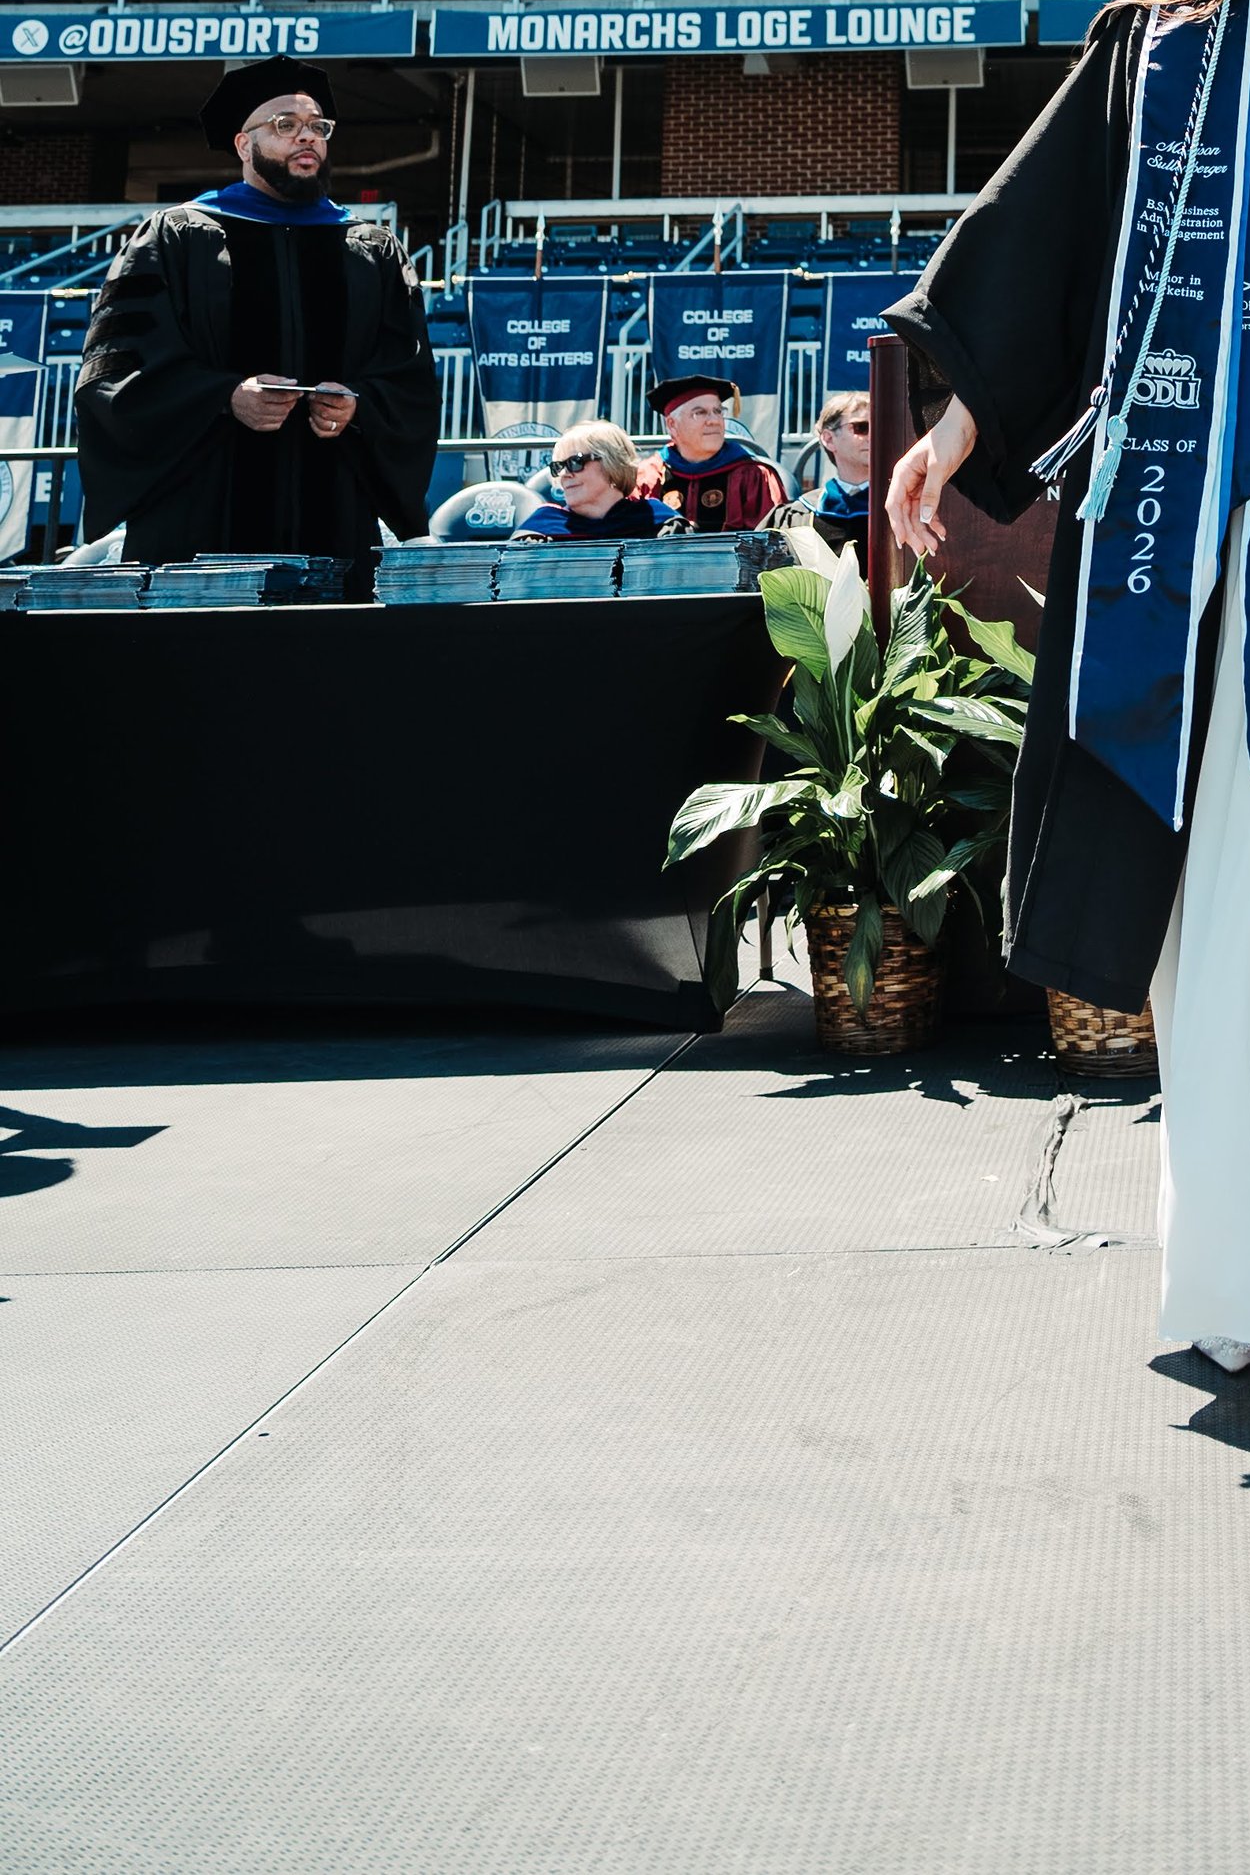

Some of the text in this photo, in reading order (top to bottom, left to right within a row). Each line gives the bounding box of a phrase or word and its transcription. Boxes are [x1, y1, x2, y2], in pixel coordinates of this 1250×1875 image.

[59, 17, 320, 55] @ODUSPORTS
[487, 7, 976, 51] MONARCHS LOGE LOUNGE
[1136, 221, 1148, 233] in
[1148, 271, 1202, 285] Mnor in
[1144, 282, 1205, 301] Maketing
[683, 309, 754, 324] COLLEGE
[507, 320, 571, 334] COLLEGE
[707, 327, 729, 341] OF
[527, 336, 547, 350] OF
[678, 344, 755, 359] SCIENCES
[478, 352, 594, 367] ARTS & LETTERS
[1131, 377, 1199, 407] ODU
[1121, 438, 1197, 453] CLASS OF
[465, 506, 516, 528] ODU
[1127, 465, 1166, 594] 2026
